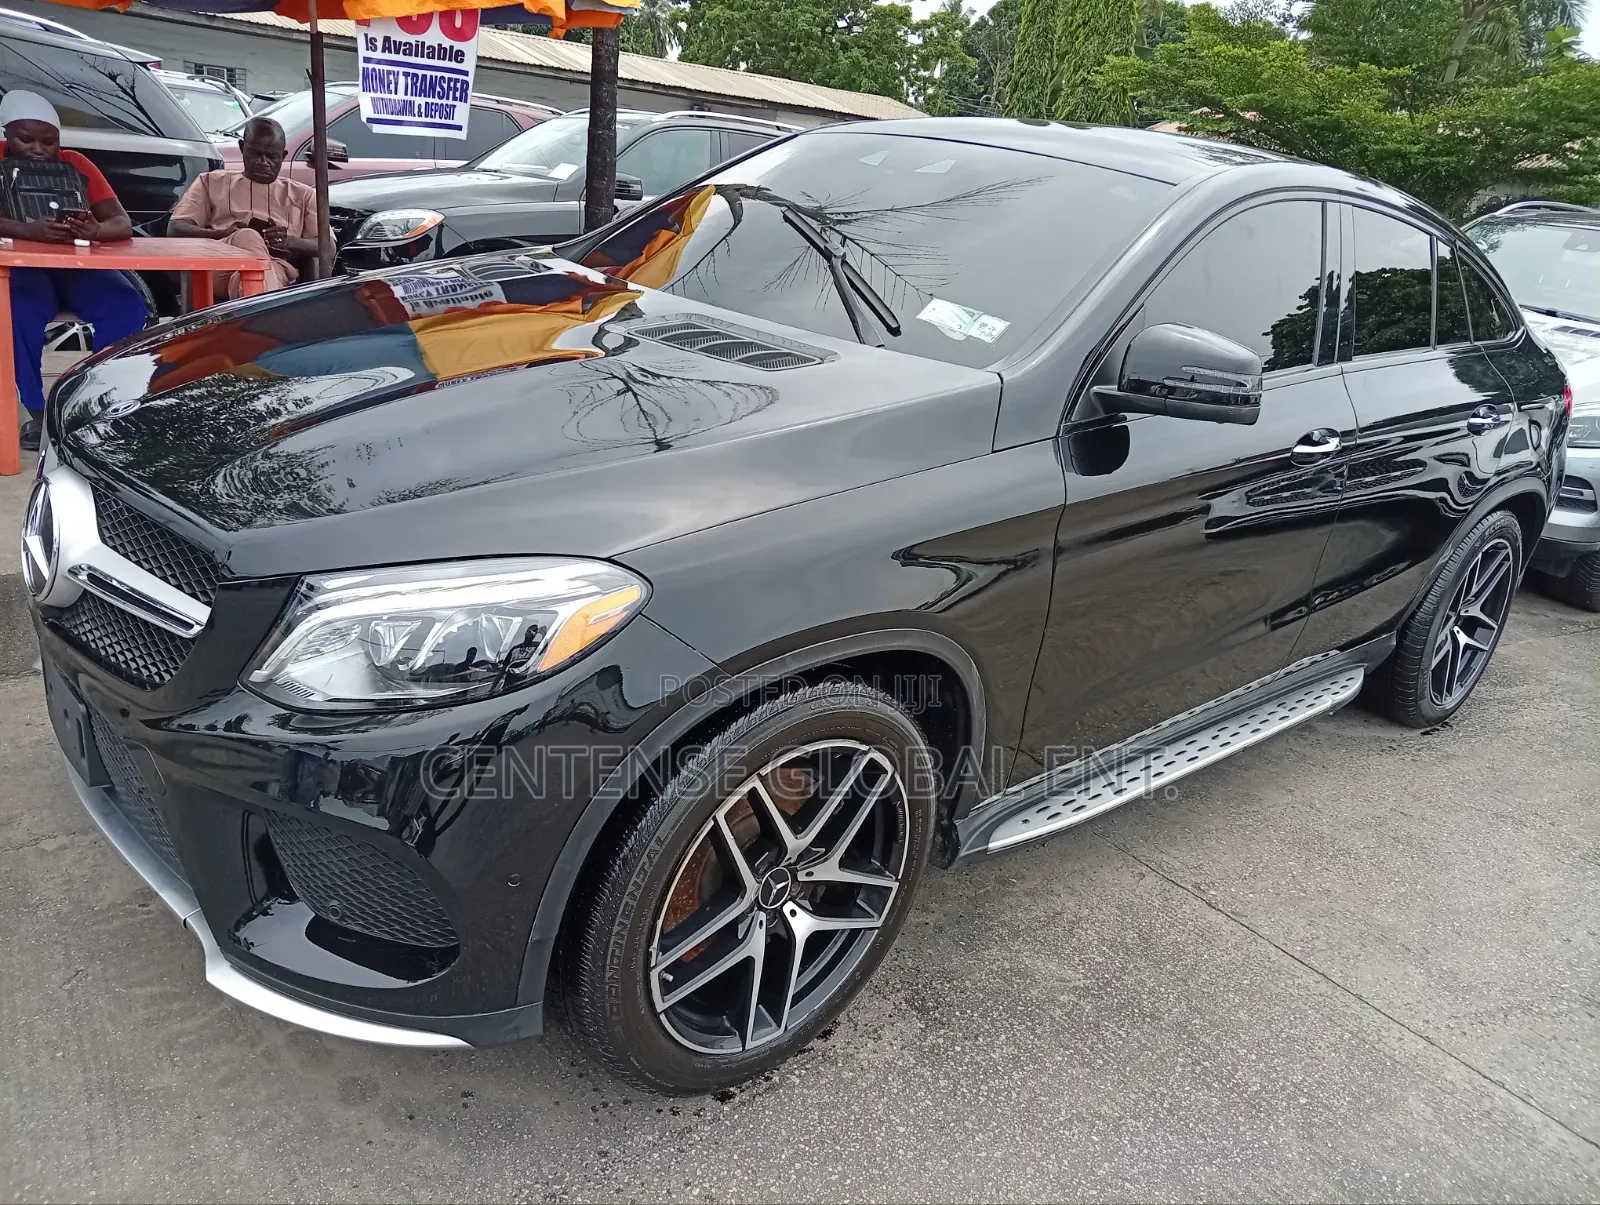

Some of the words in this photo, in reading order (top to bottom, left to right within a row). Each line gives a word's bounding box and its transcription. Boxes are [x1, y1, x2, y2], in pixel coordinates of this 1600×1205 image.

[364, 33, 377, 52] Is
[381, 36, 465, 64] Available
[362, 67, 400, 95] MONEY
[402, 71, 470, 104] TRANSFER
[371, 97, 416, 117] WITHDRAWAL
[418, 105, 422, 118] &
[424, 102, 457, 120] DEPOSIT
